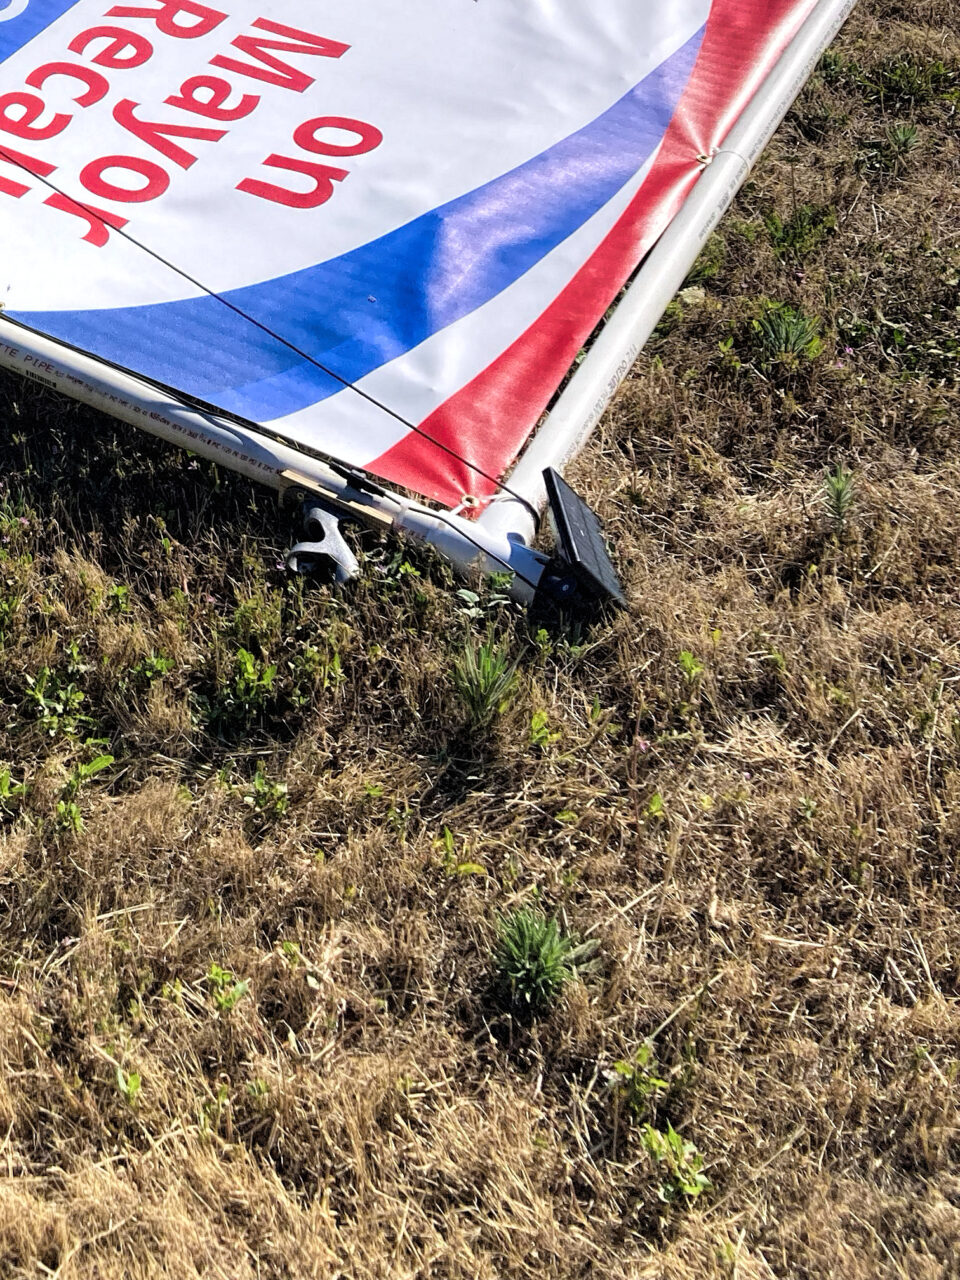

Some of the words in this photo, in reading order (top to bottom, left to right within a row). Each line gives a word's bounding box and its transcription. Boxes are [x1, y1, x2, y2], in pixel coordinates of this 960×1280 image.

[42, 17, 352, 248] Mayor
[235, 116, 383, 208] on
[23, 354, 55, 374] PIPE
